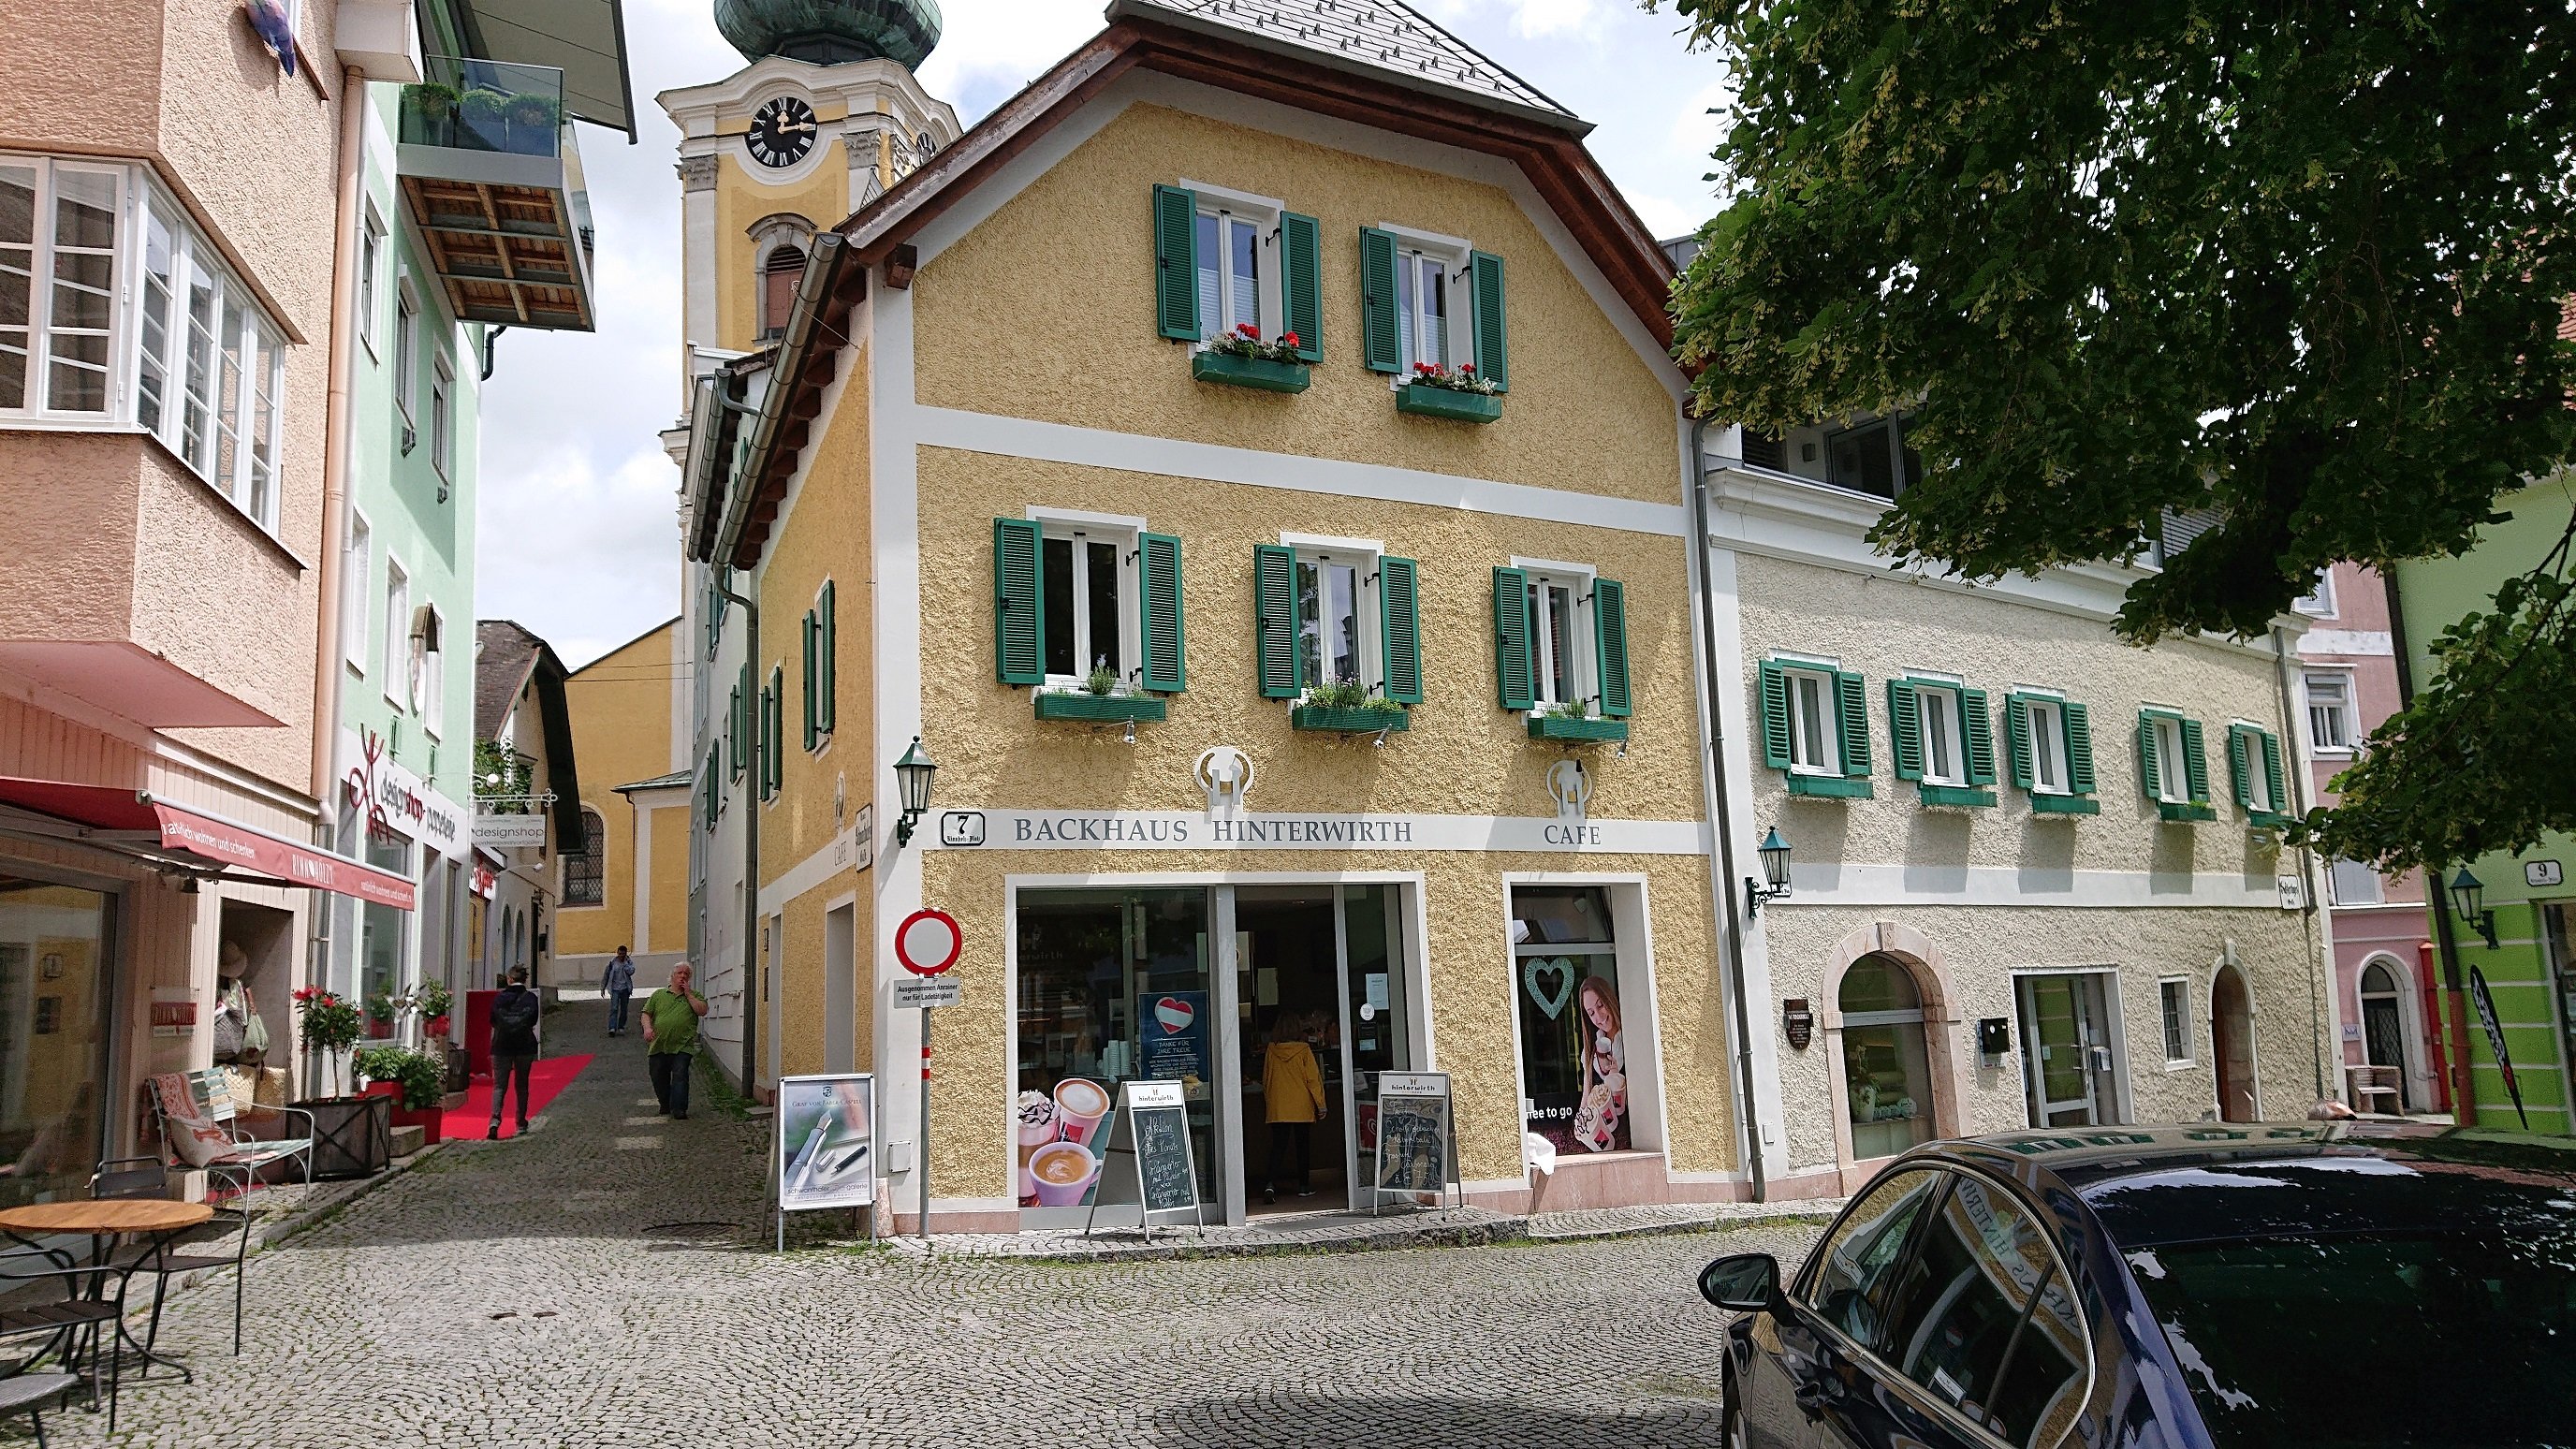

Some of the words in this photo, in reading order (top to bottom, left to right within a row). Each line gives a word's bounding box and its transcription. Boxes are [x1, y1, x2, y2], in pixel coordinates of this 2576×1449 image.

[958, 815, 969, 834] 7
[1014, 818, 1188, 842] BACKHAUS
[1212, 820, 1412, 842] HINTERWIRTH
[475, 827, 544, 839] designshop
[1544, 825, 1601, 844] CAFE
[217, 837, 229, 852] und
[2538, 863, 2547, 877] 9
[897, 985, 936, 993] Ausgenommen
[920, 992, 953, 1001] Ladetätigkeit
[1546, 1106, 1557, 1118] to
[1559, 1106, 1573, 1120] go
